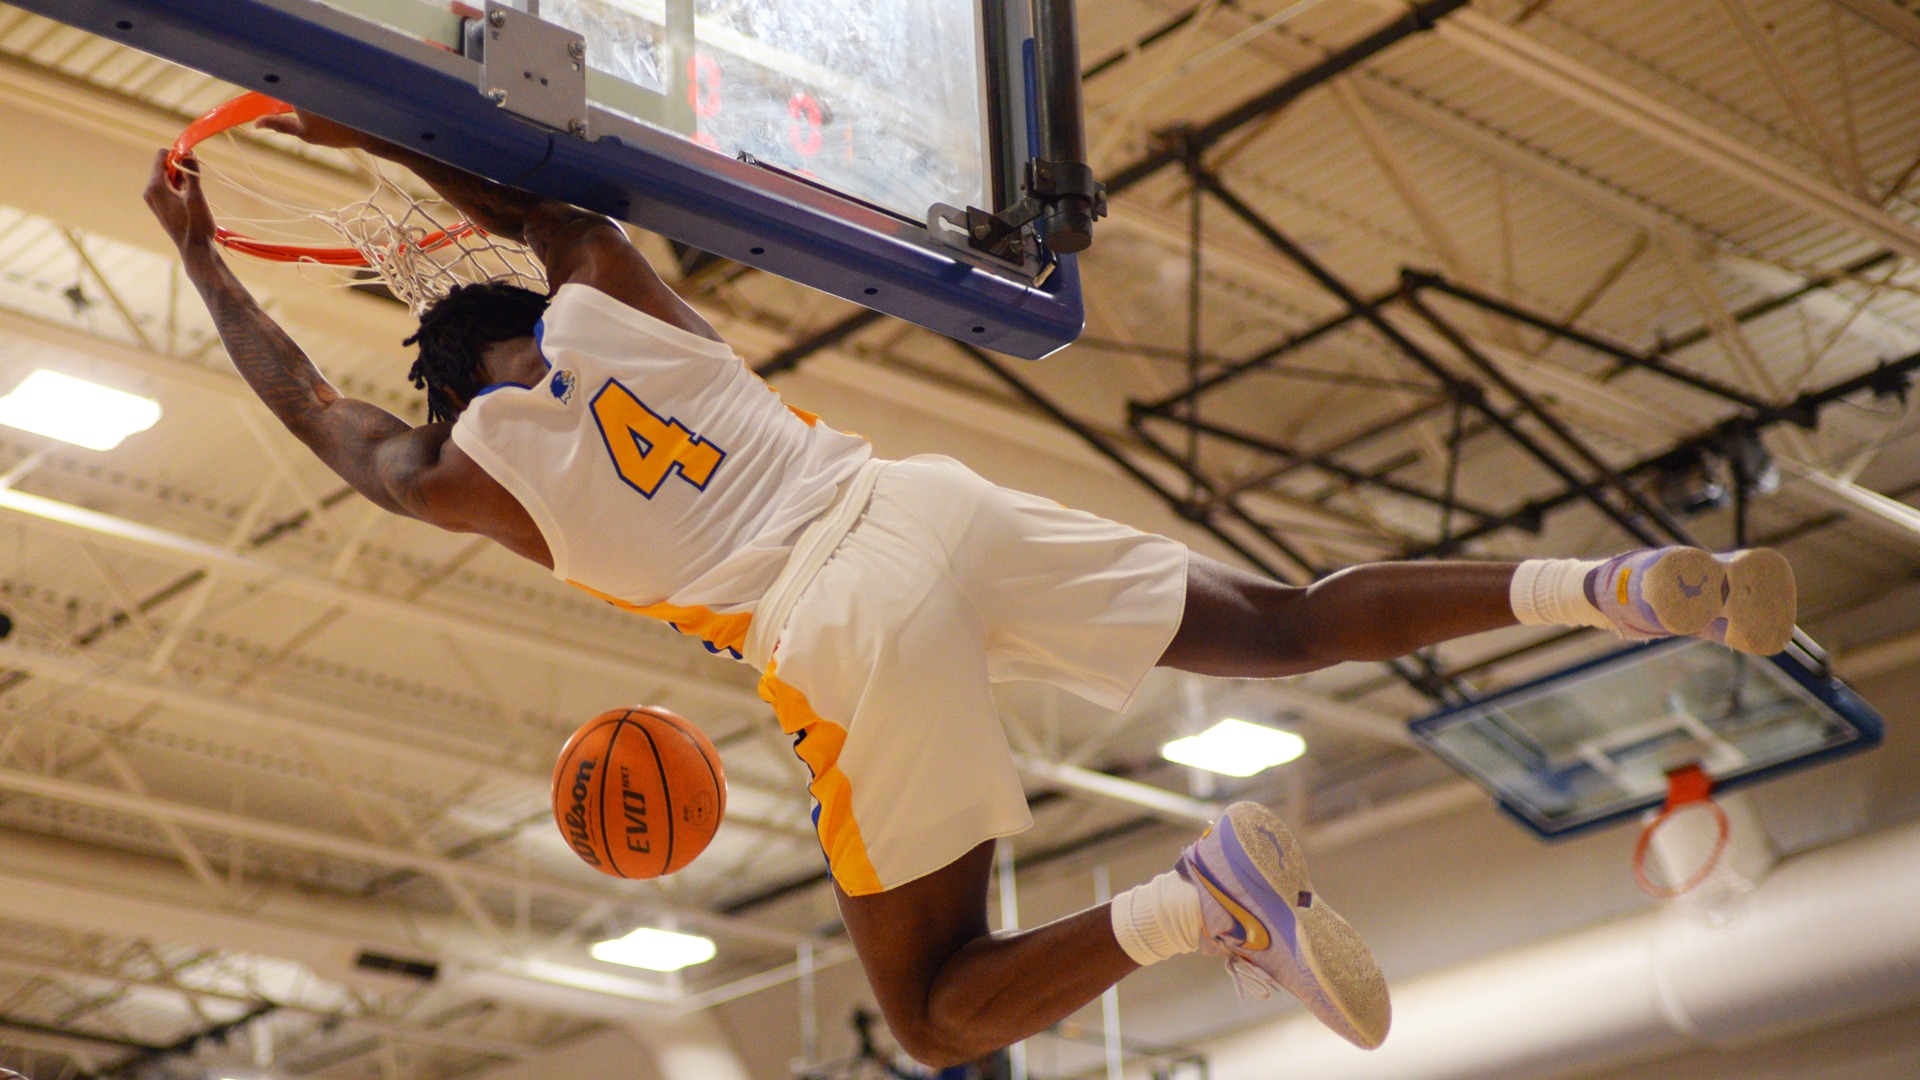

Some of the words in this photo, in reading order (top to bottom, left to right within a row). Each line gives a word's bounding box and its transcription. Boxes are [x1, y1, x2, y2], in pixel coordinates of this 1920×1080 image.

[589, 377, 727, 500] 4
[565, 757, 601, 866] Wilson
[622, 789, 650, 854] EVO
